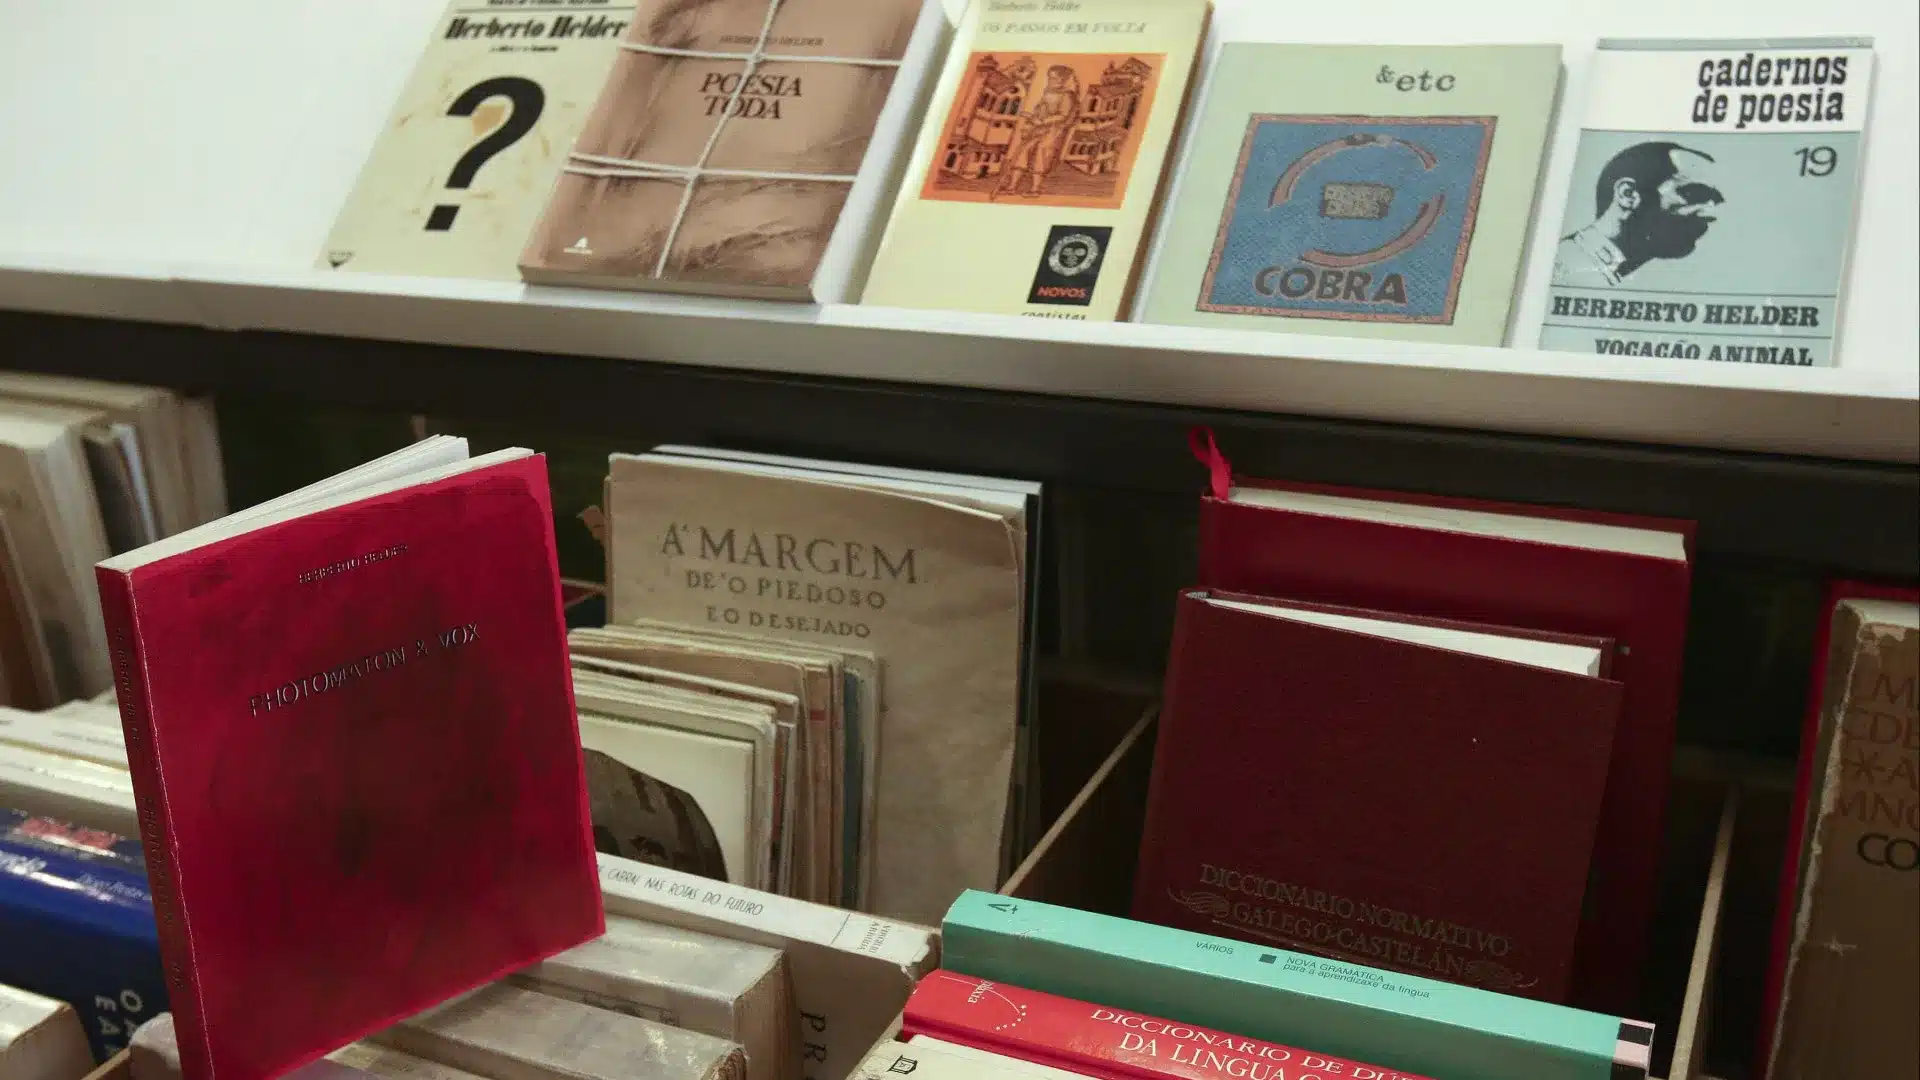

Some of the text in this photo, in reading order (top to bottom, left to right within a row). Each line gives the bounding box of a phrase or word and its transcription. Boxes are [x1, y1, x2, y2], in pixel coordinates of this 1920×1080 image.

[444, 17, 545, 40] Herberto
[698, 72, 802, 97] POESIA
[1699, 56, 1848, 89] cadernos
[703, 95, 781, 119] TODA
[1692, 87, 1845, 129] de poesia
[1794, 146, 1838, 177] 19
[1037, 286, 1088, 298] NOVOS
[1255, 265, 1408, 305] COBRA
[1552, 295, 1820, 328] HERBERTO HELDER
[1708, 345, 1814, 367] ANIMAL
[699, 525, 918, 584] MARGEM
[757, 576, 887, 609] PIEDOSO
[749, 610, 872, 638] DESEJADO
[250, 646, 407, 718] PHOTOMATON
[438, 622, 481, 649] VOX
[724, 896, 764, 916] FUTURO
[1200, 863, 1510, 957] DICCIONARIO NORMATIVO
[1282, 963, 1307, 974] para
[1317, 969, 1379, 989] aprendizaxe
[1381, 981, 1395, 992] da
[1286, 955, 1316, 969] NOVA
[1091, 1008, 1290, 1062] DICCIONARIO
[1300, 1055, 1344, 1074] DE
[1119, 1031, 1286, 1080] DA LINGUA
